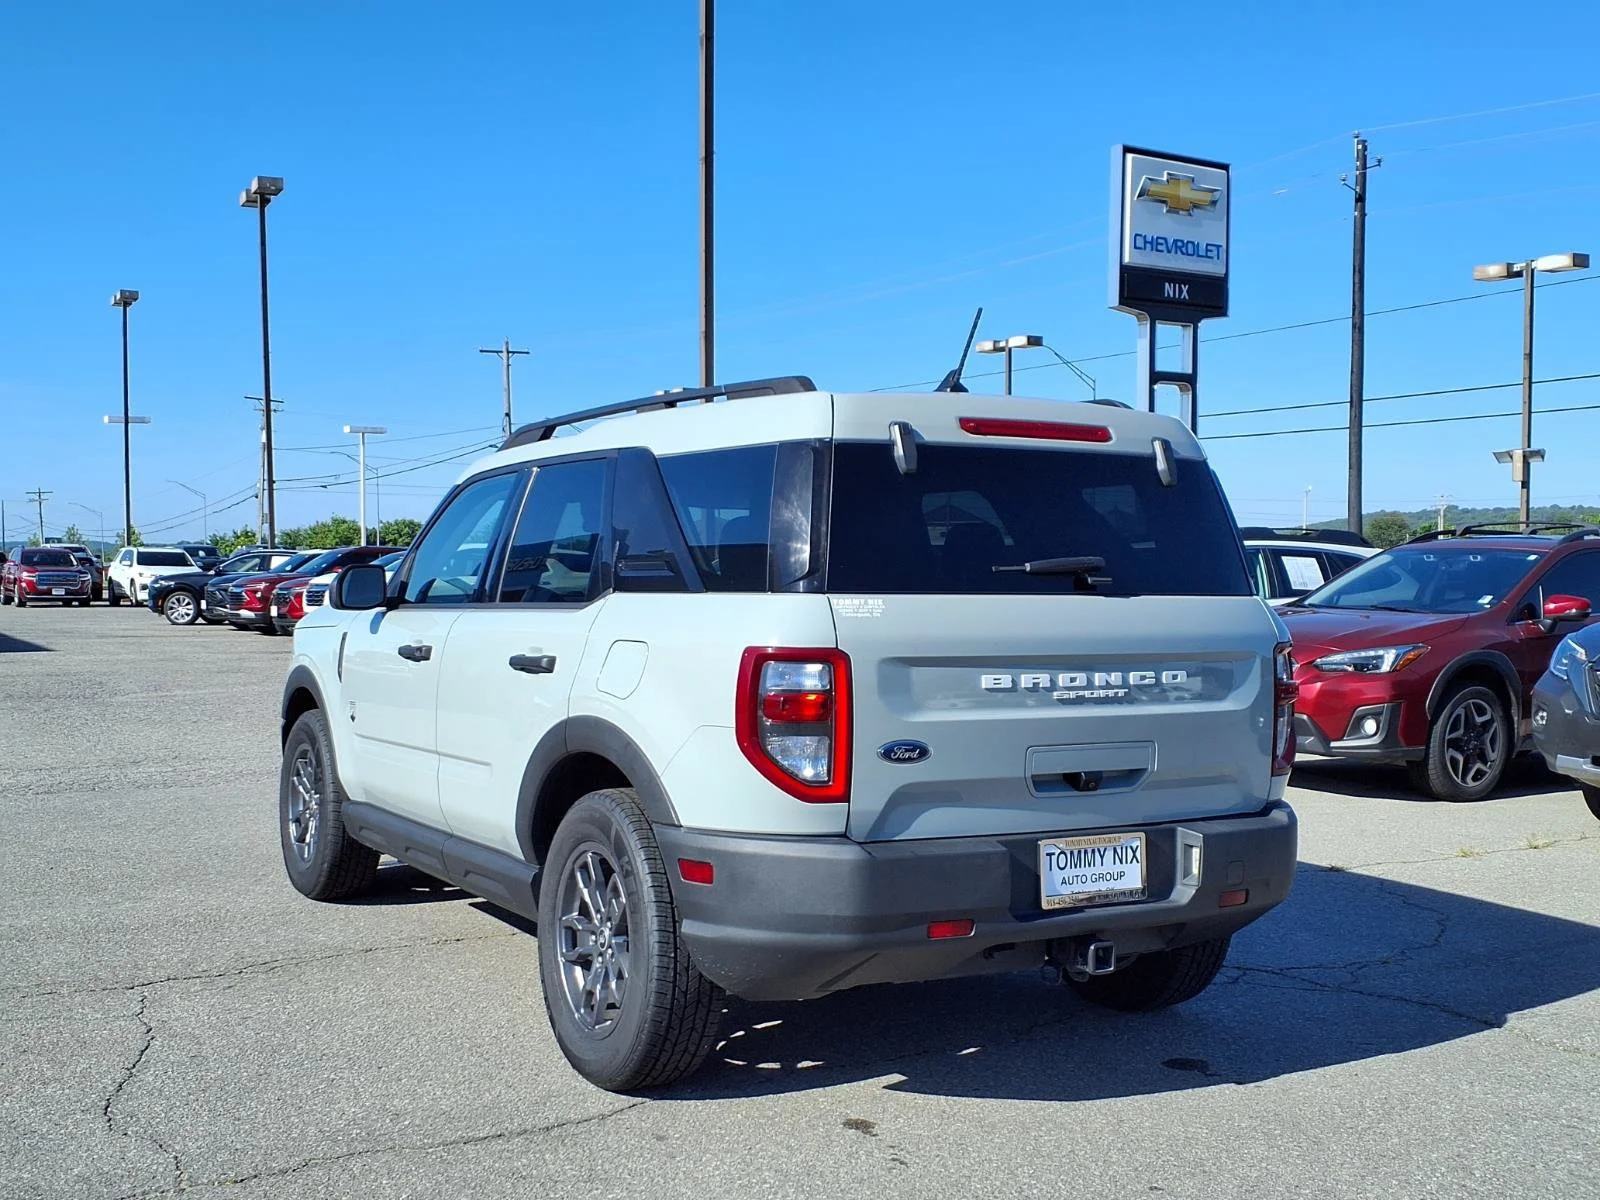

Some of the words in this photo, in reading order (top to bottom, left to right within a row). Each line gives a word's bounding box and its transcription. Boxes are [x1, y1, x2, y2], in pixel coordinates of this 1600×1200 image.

[1133, 232, 1223, 260] CHEVROLET
[1164, 282, 1190, 300] NIX
[981, 670, 1188, 689] BRONCO
[1052, 688, 1129, 700] SPORT
[890, 745, 920, 759] Ford
[1045, 847, 1107, 871] TOMMY
[1113, 845, 1140, 865] NIX
[1060, 873, 1088, 887] AUTO
[1090, 870, 1126, 884] GROUP
